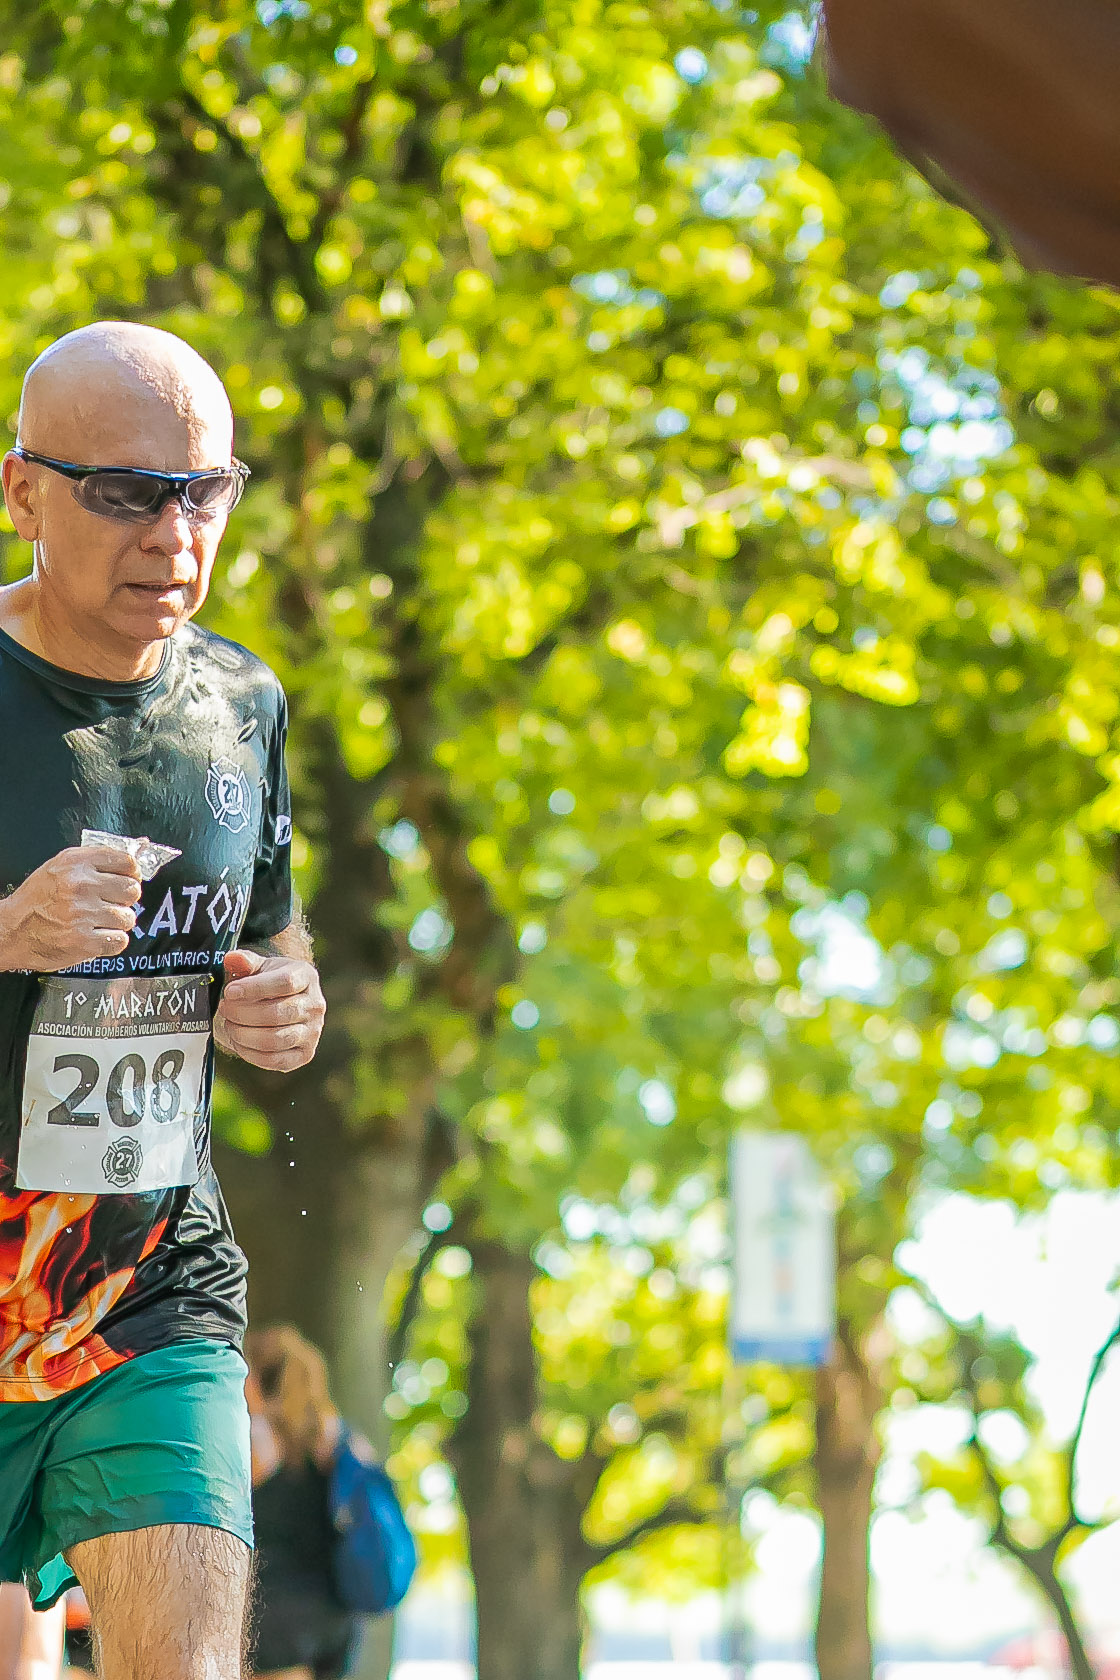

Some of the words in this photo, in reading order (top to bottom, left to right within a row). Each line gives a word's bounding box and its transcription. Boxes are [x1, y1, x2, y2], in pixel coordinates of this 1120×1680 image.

[94, 981, 197, 1019] MARATÓN
[37, 1022, 94, 1037] ASOCIACIÓN
[95, 1023, 138, 1038] BOMBEROS
[47, 1049, 185, 1128] 208
[115, 1151, 134, 1170] 27
